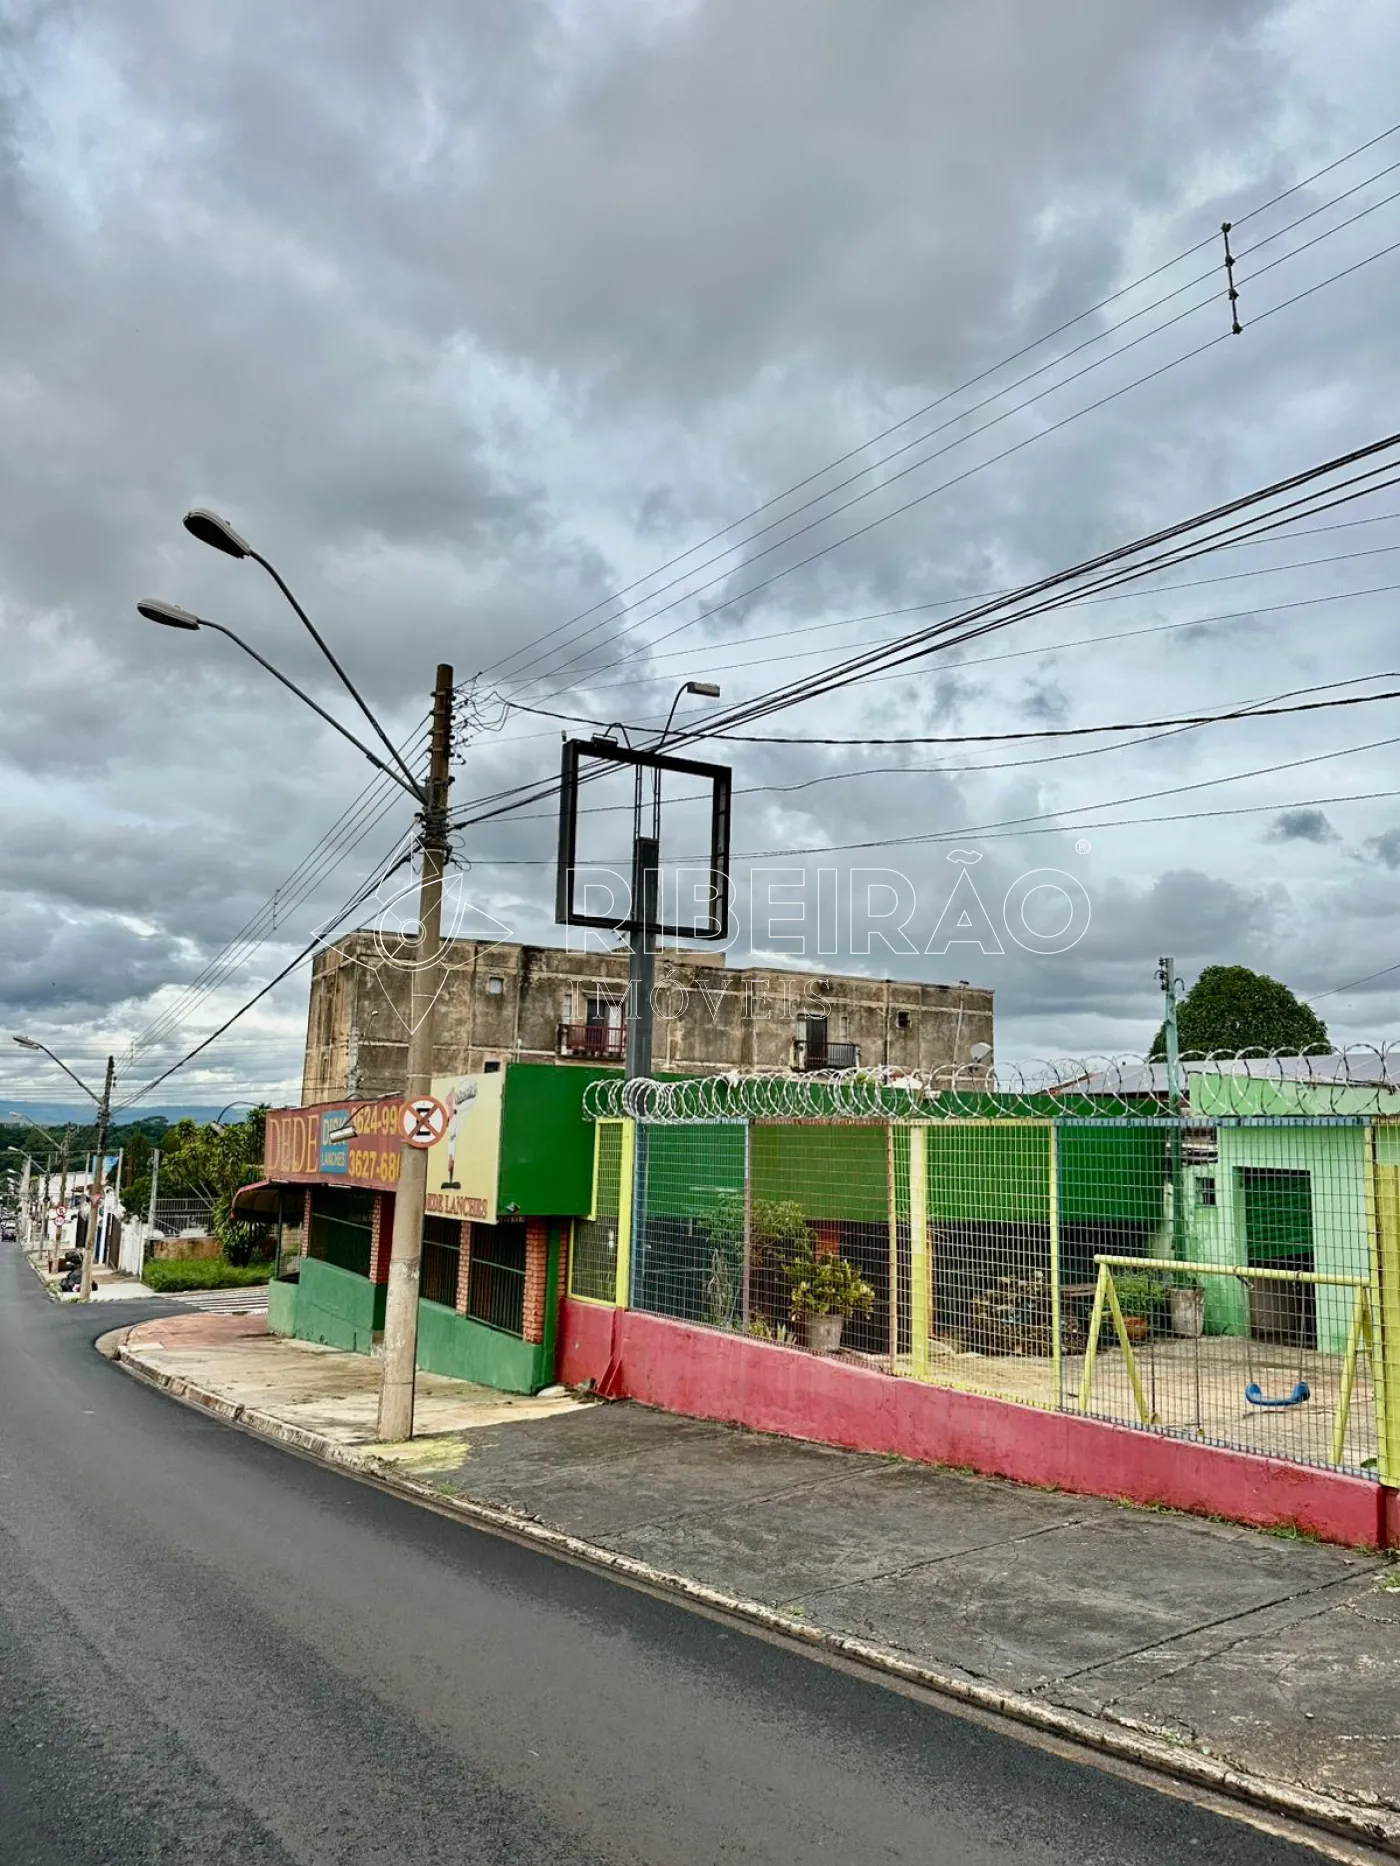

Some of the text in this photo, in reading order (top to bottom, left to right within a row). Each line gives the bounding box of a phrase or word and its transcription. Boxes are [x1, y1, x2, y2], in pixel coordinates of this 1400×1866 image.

[351, 1104, 401, 1135] 3624-99
[268, 1114, 320, 1173] DEDE
[426, 1192, 488, 1219] EDE LANCHES
